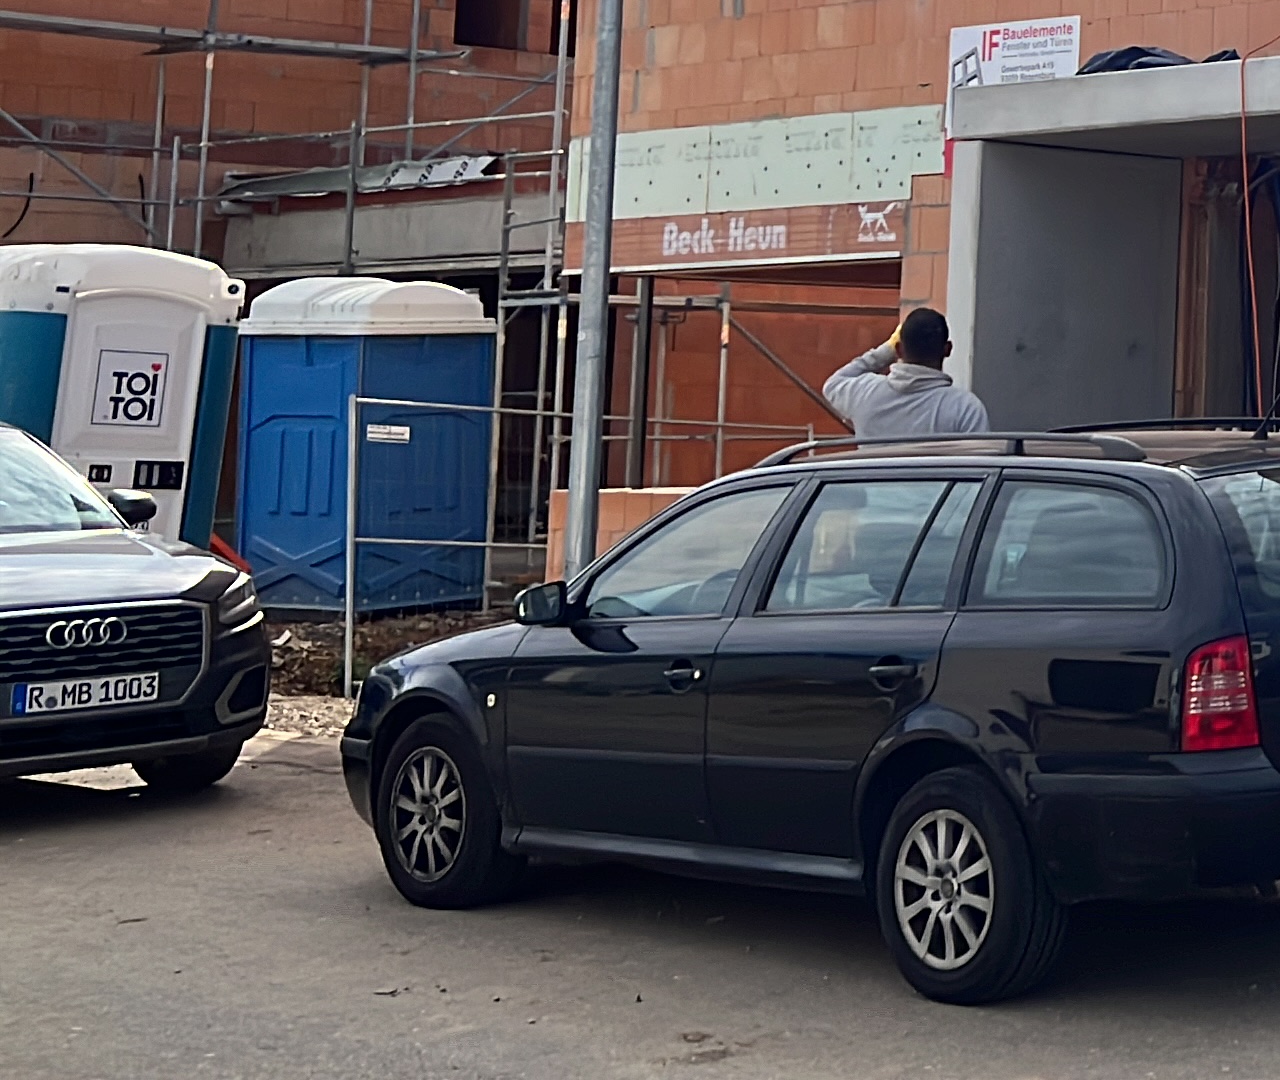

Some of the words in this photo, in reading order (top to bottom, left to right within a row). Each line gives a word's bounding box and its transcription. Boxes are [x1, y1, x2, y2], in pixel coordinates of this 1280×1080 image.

[1002, 23, 1074, 41] Bauelemente
[1002, 40, 1031, 52] Fenster
[1032, 39, 1048, 48] und
[1050, 37, 1073, 47] Türen
[662, 218, 716, 256] Beck
[727, 216, 787, 252] Heun
[112, 371, 159, 397] TOI
[109, 396, 156, 422] TOI
[28, 686, 44, 710] R
[61, 682, 92, 707] MB
[98, 675, 157, 703] 1003
